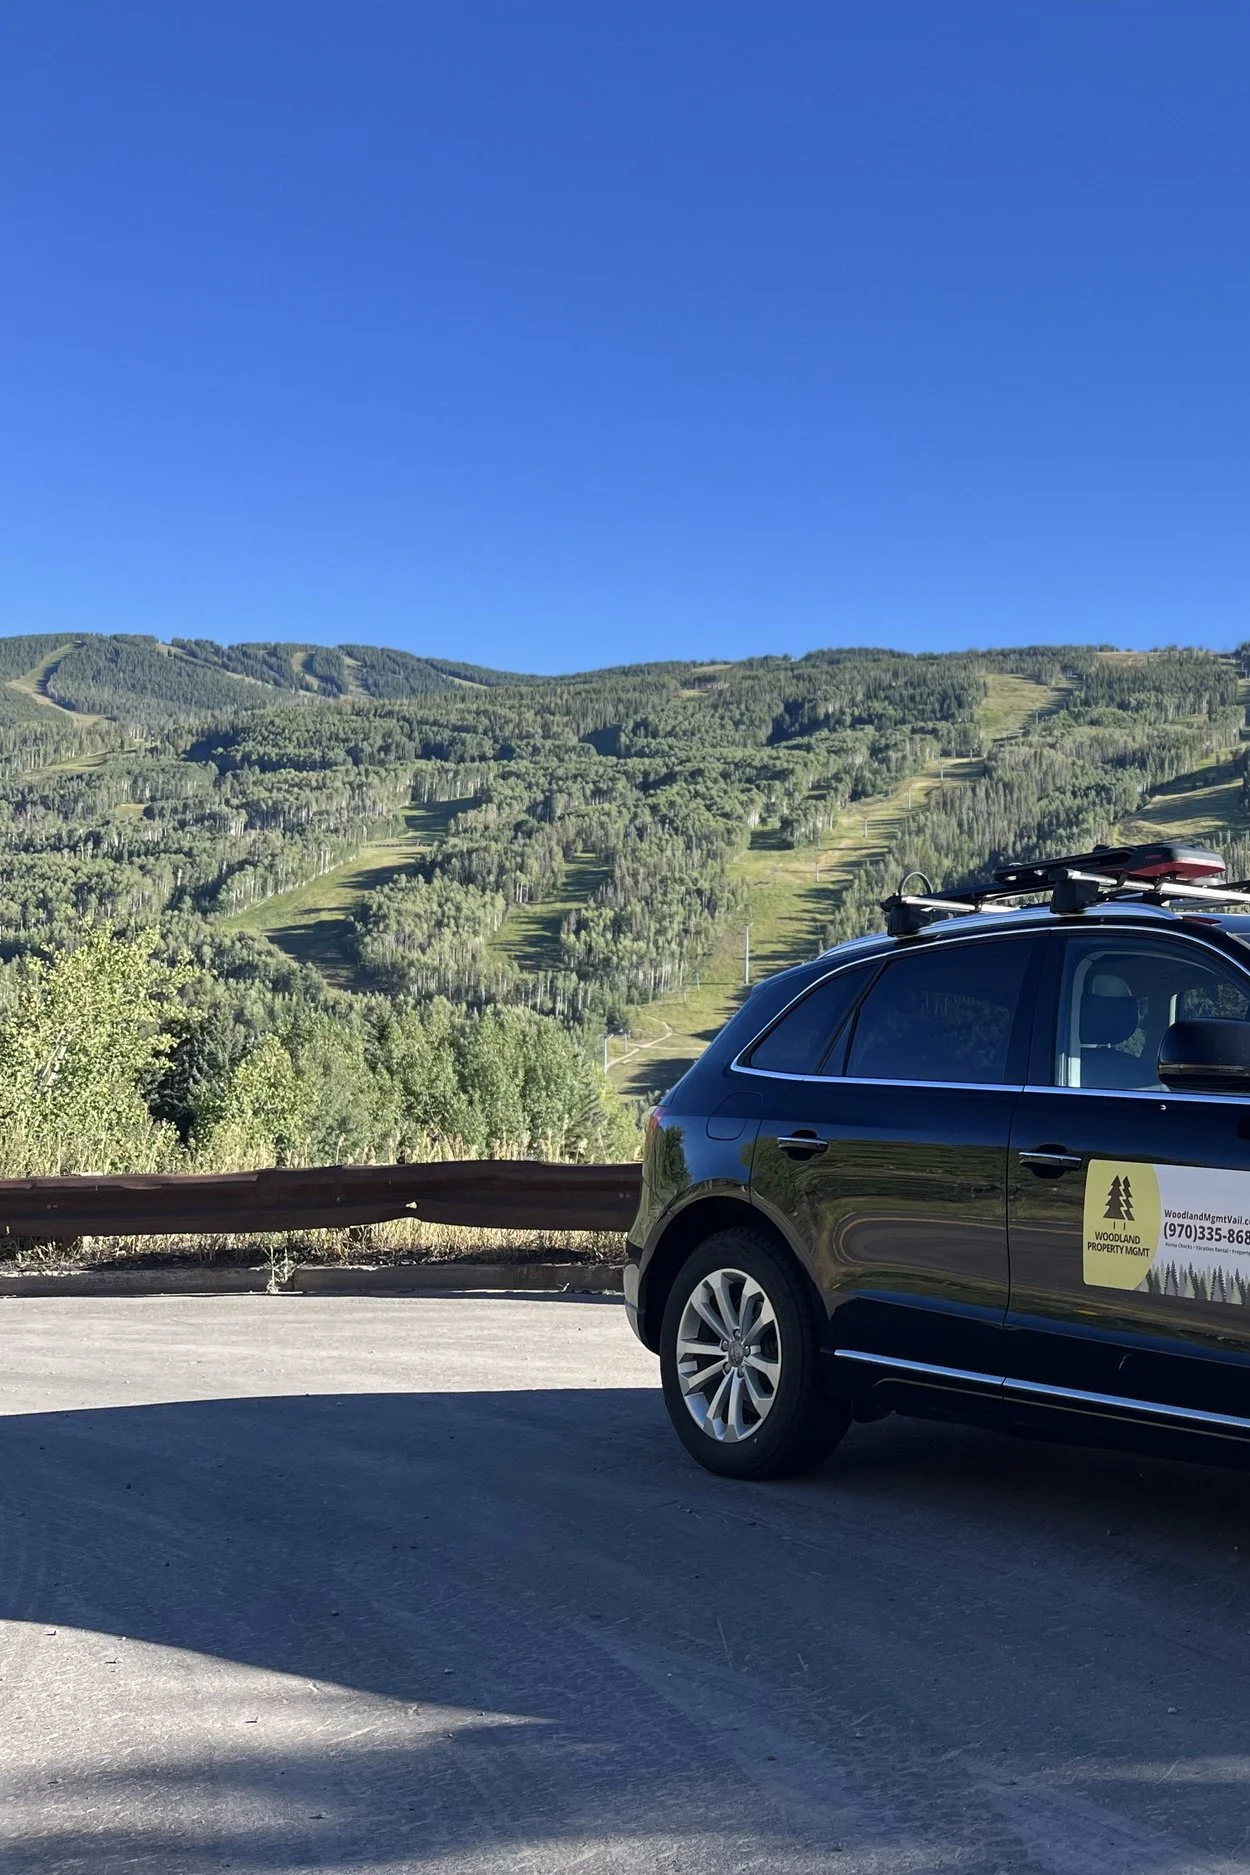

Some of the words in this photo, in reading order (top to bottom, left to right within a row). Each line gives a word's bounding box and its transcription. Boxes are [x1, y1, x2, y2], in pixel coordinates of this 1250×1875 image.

[1095, 1231, 1141, 1245] WOODLAND
[1087, 1241, 1124, 1255] PROPERTY
[1125, 1245, 1150, 1257] MGMT
[1231, 1249, 1250, 1257] Property
